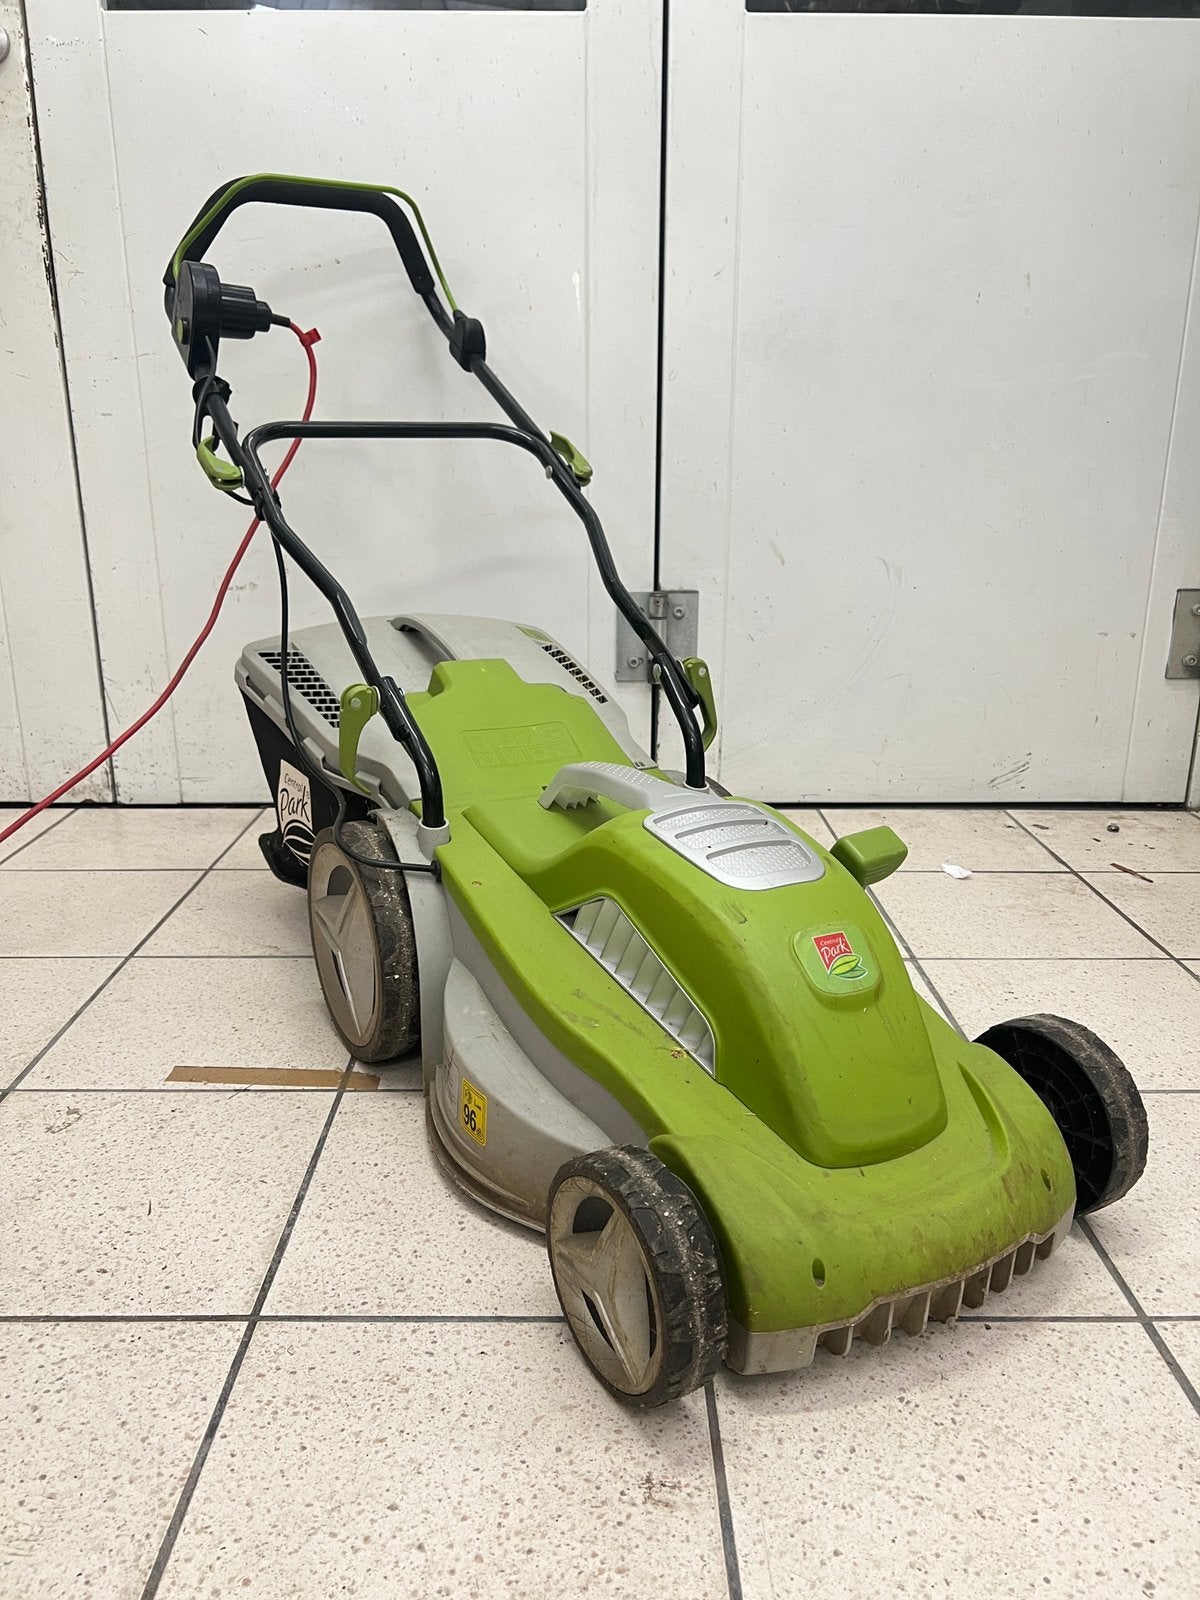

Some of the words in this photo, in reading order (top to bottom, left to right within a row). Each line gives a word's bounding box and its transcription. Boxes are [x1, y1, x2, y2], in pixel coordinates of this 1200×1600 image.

[284, 773, 303, 793] Central
[280, 785, 310, 823] Park
[820, 937, 851, 965] Park
[463, 1103, 477, 1132] 96
